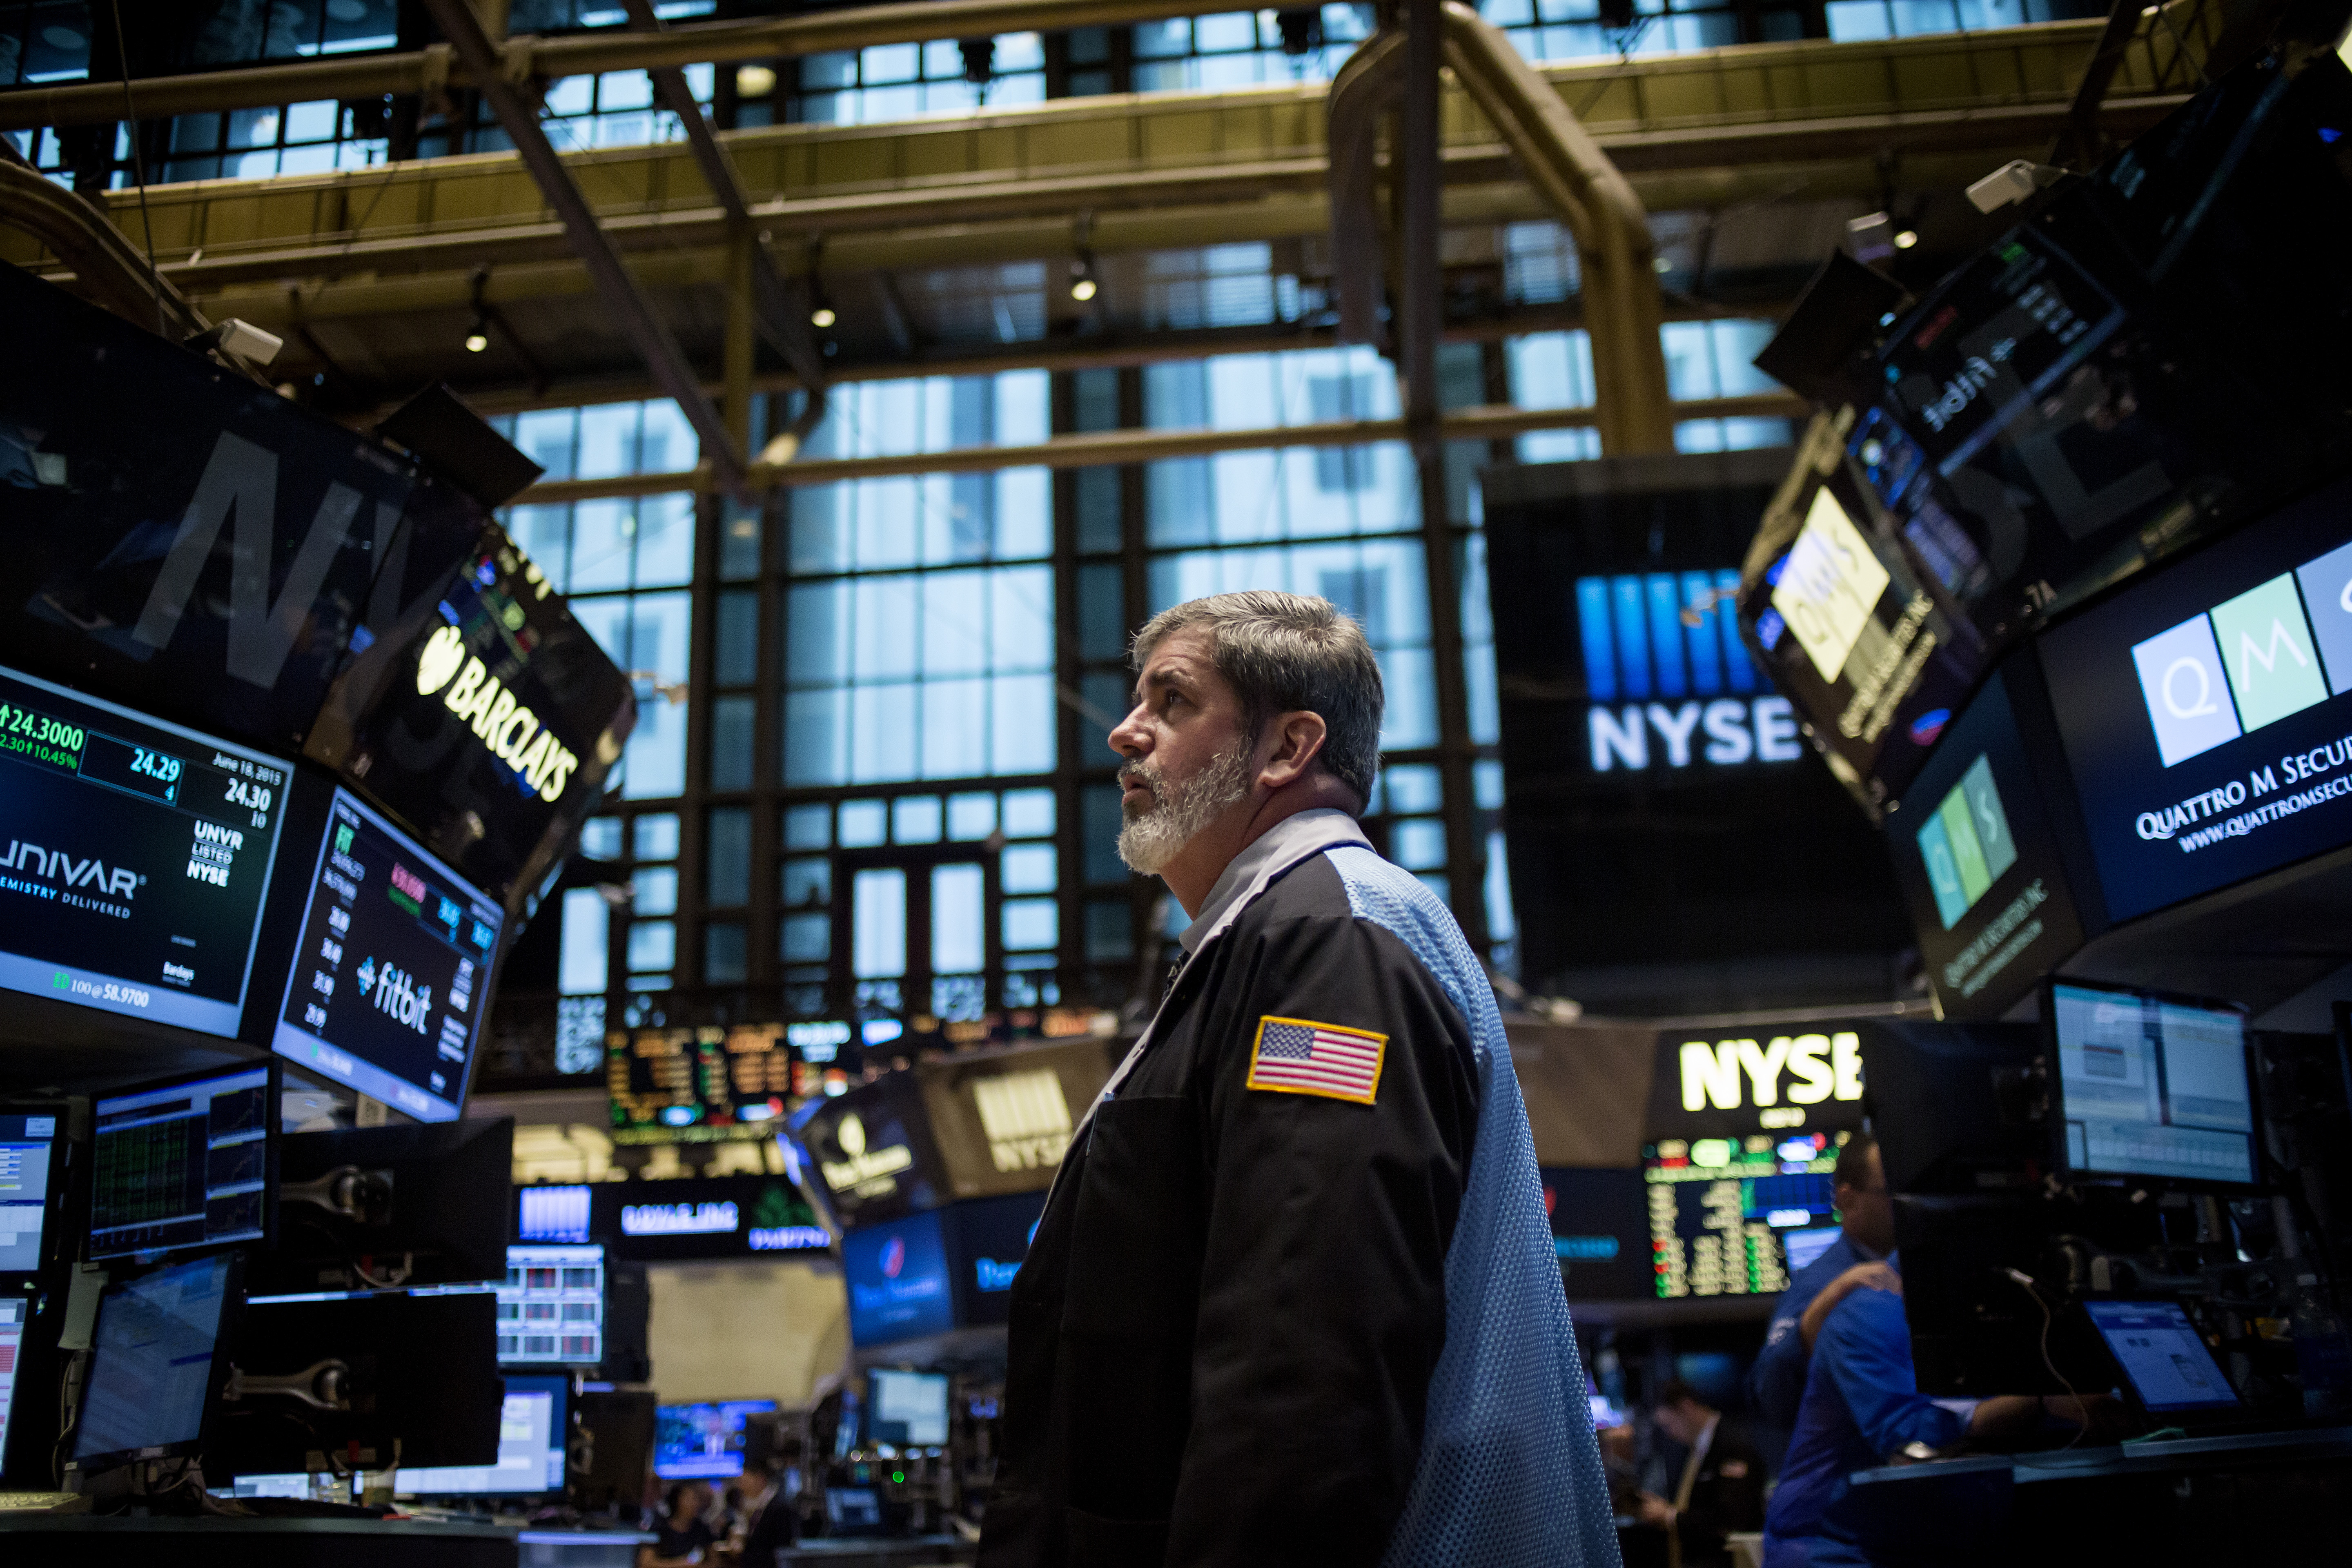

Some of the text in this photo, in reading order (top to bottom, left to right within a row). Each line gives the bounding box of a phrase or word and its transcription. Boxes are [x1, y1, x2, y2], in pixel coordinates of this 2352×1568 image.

[8, 709, 84, 751] 24.3000
[444, 655, 578, 802] BARCLAYS
[1587, 695, 1802, 771] NYSE
[130, 748, 180, 782] 24.29
[212, 752, 237, 772] June
[165, 785, 175, 801] 4
[225, 778, 271, 812] 24.30
[2135, 781, 2246, 840] QUATTRO
[2250, 765, 2280, 797] M
[194, 820, 243, 851] UNVR
[251, 810, 266, 829] 10
[192, 842, 233, 865] LISTED
[187, 860, 229, 887] NYSE
[62, 892, 131, 919] DELIVERED
[374, 961, 432, 1035] fitbit
[1680, 1032, 1863, 1111] NYSE
